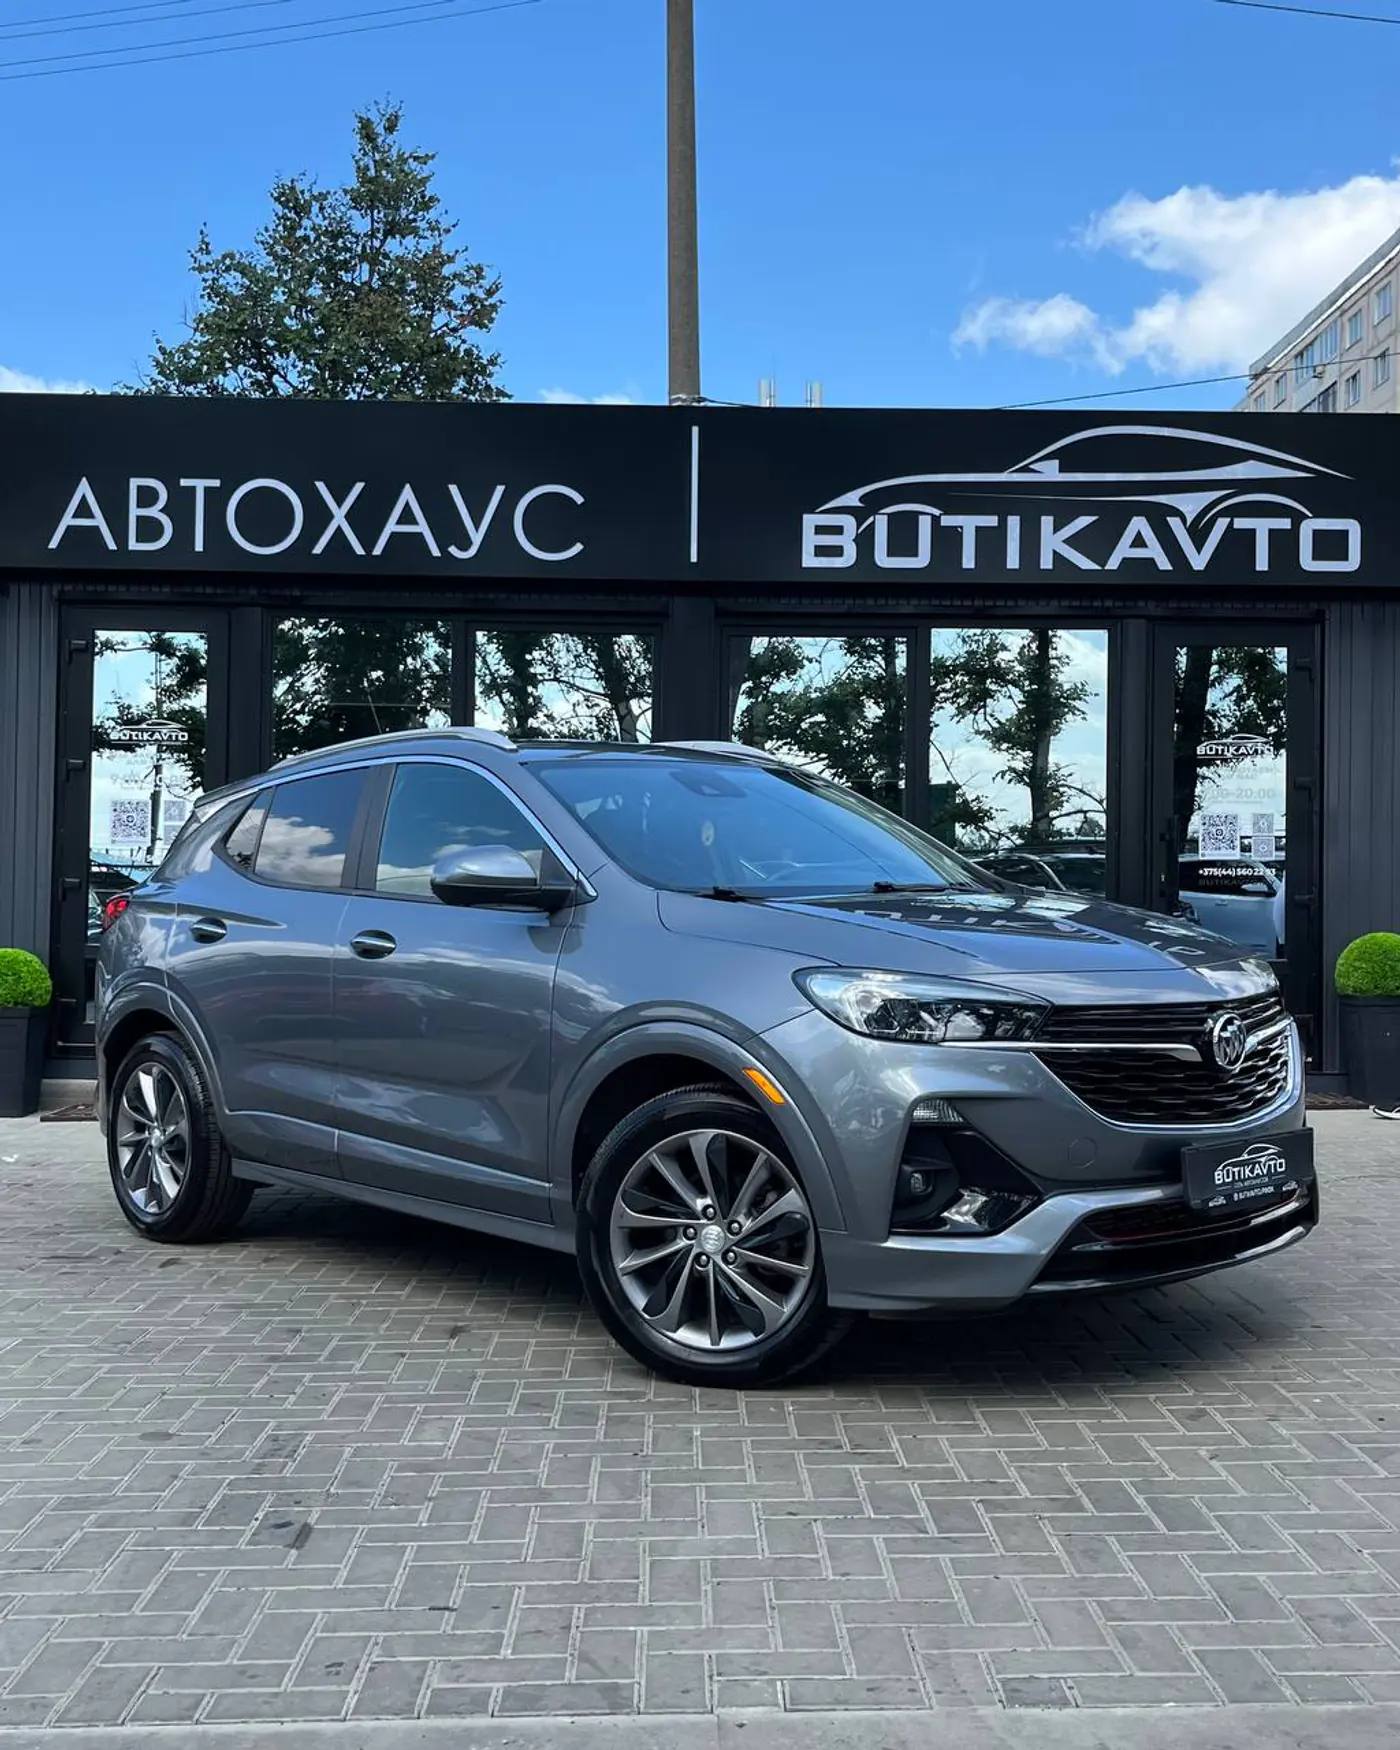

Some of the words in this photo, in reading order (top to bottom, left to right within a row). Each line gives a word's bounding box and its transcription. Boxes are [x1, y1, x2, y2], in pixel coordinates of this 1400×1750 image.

[48, 476, 585, 561] АВТОХАУС
[802, 512, 1362, 573] BUTIKAVTO
[109, 730, 189, 742] BUTIKAVTO
[1196, 744, 1274, 756] BUTIKAVTO
[1214, 1159, 1285, 1185] BUTIKAVTO
